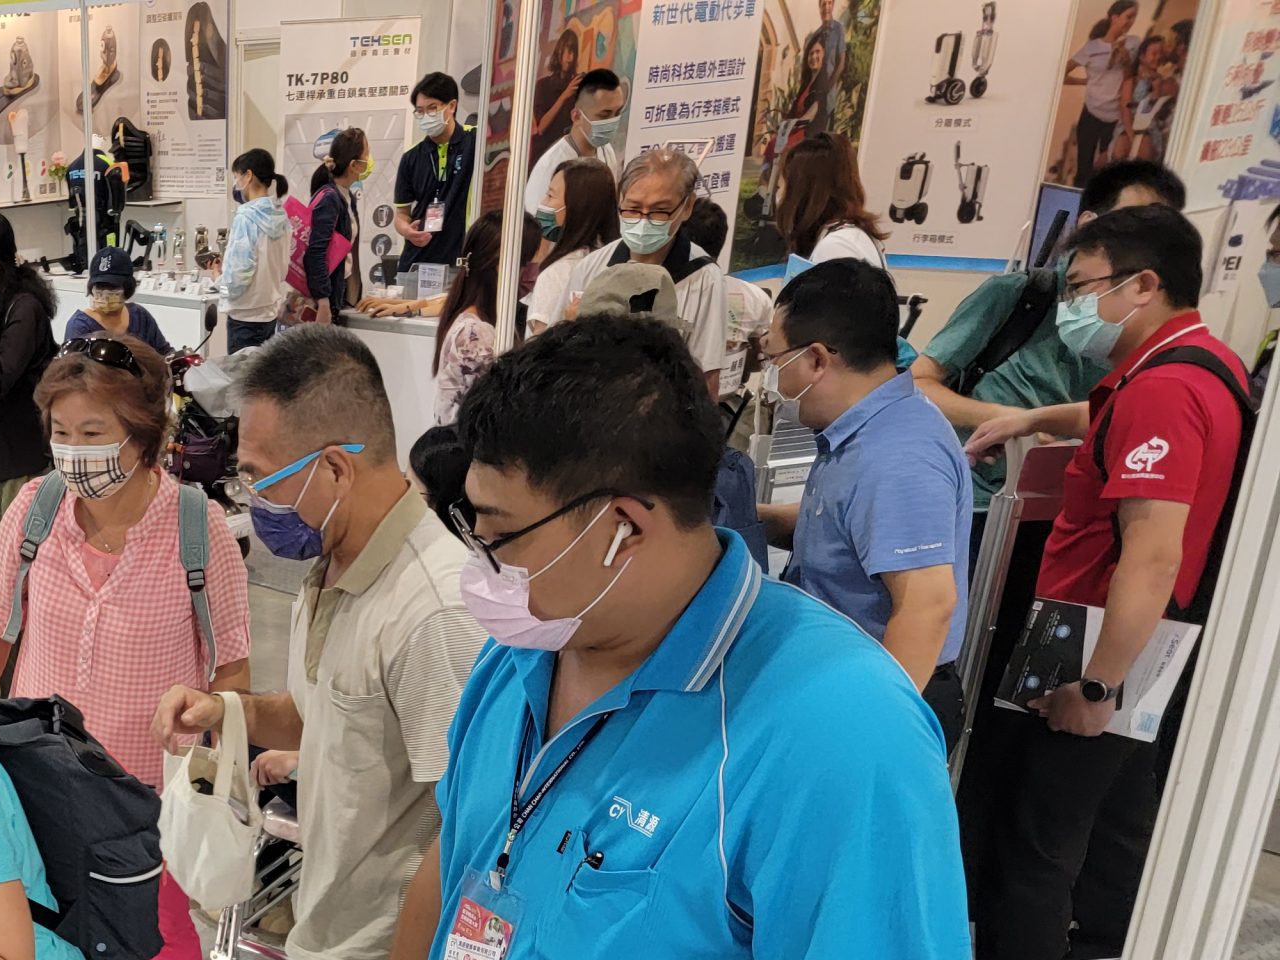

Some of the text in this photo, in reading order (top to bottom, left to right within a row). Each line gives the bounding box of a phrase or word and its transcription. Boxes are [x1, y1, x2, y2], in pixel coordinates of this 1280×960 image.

[286, 71, 349, 86] TK-7P80
[648, 57, 746, 83] 時尚科技感外型設計
[644, 96, 741, 123] 可折疊為行李箱模式
[521, 804, 534, 818] CHAN
